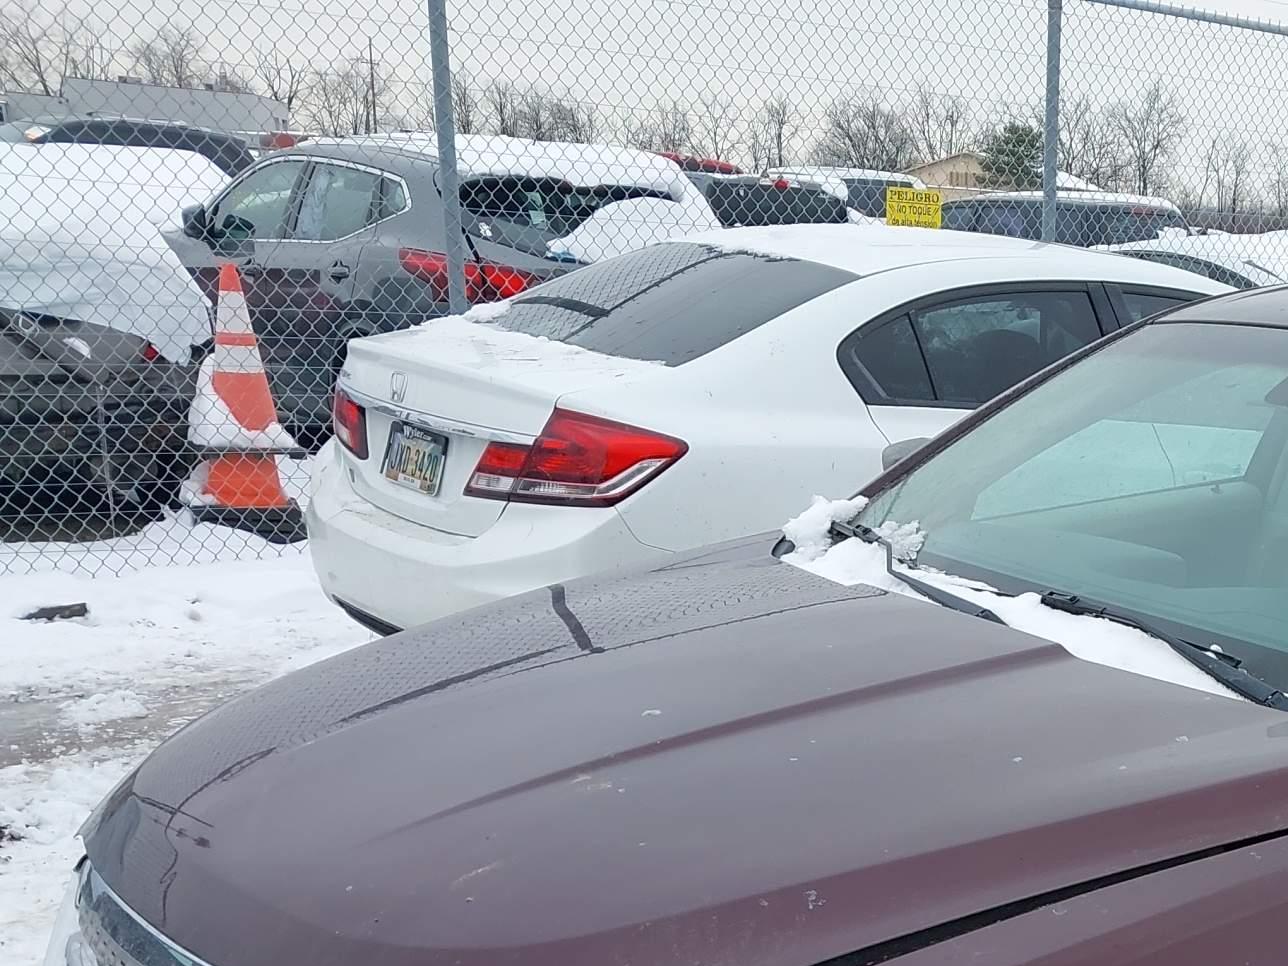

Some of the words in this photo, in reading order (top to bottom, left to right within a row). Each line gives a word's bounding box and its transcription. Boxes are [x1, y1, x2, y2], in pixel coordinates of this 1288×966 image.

[889, 190, 940, 203] PELIGRO
[896, 203, 907, 214] NO
[909, 204, 932, 216] TOQUE
[411, 449, 439, 483] 3420
